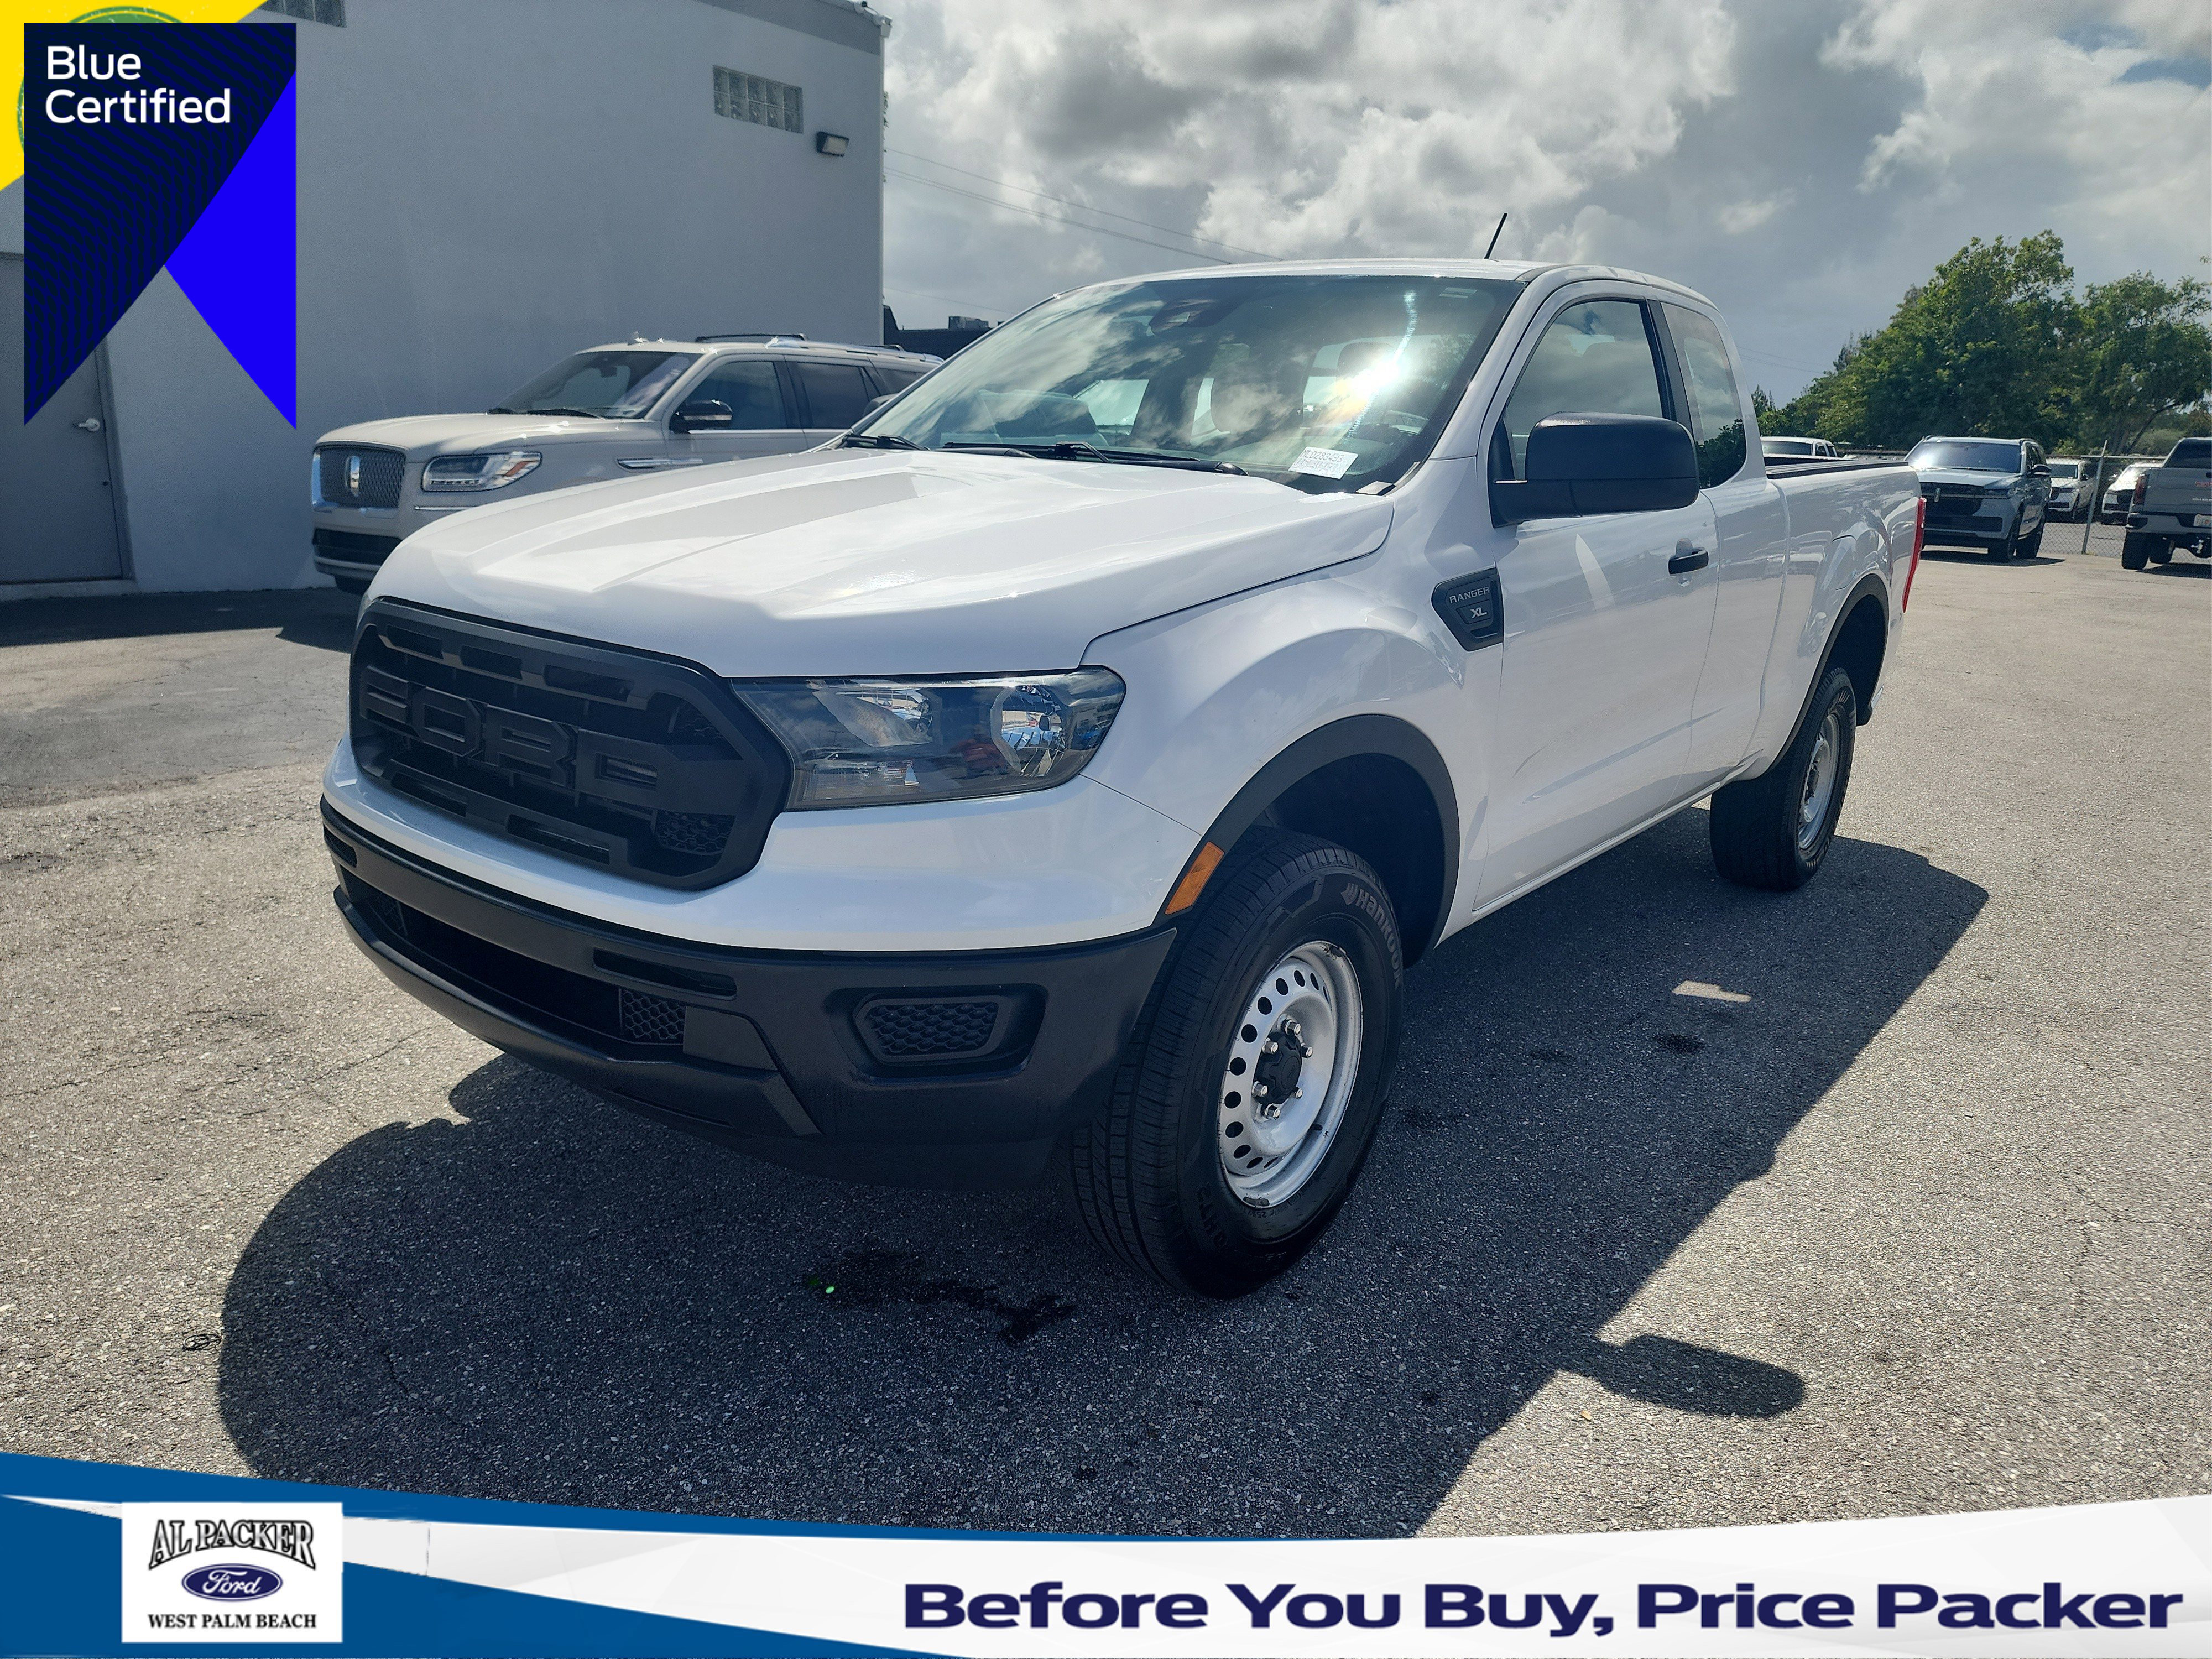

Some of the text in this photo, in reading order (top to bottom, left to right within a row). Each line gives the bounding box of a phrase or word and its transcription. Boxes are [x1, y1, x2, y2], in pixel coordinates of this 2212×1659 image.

[1449, 586, 1490, 604] RANGER
[1470, 607, 1488, 619] XL
[359, 665, 677, 808] FORD
